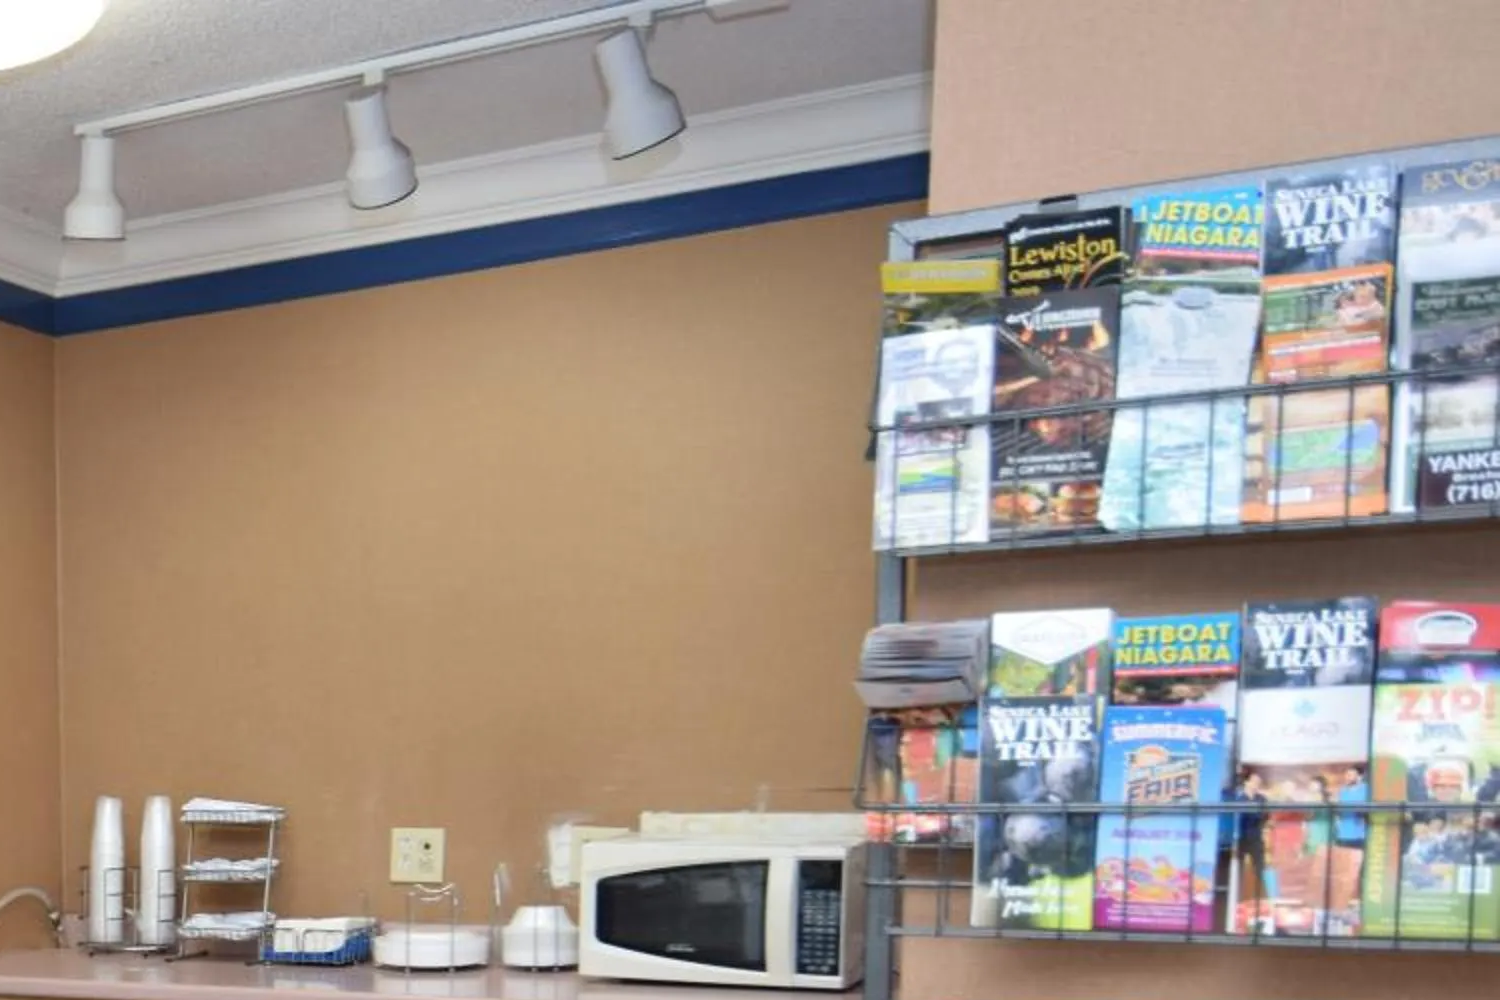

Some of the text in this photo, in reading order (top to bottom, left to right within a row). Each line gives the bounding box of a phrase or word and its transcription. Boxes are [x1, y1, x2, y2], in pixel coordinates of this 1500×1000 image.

[1276, 190, 1389, 229] WINE
[1146, 222, 1260, 246] NIAGARA
[1281, 218, 1379, 249] TRAIL
[1009, 233, 1117, 267] Lewiston
[1117, 621, 1232, 645] JETBOAT
[1254, 620, 1370, 650] WINE
[1114, 643, 1232, 666] NIAGARA
[1262, 646, 1357, 670] TRAIL
[988, 716, 1094, 742] WINE
[995, 740, 1082, 761] TRAIL
